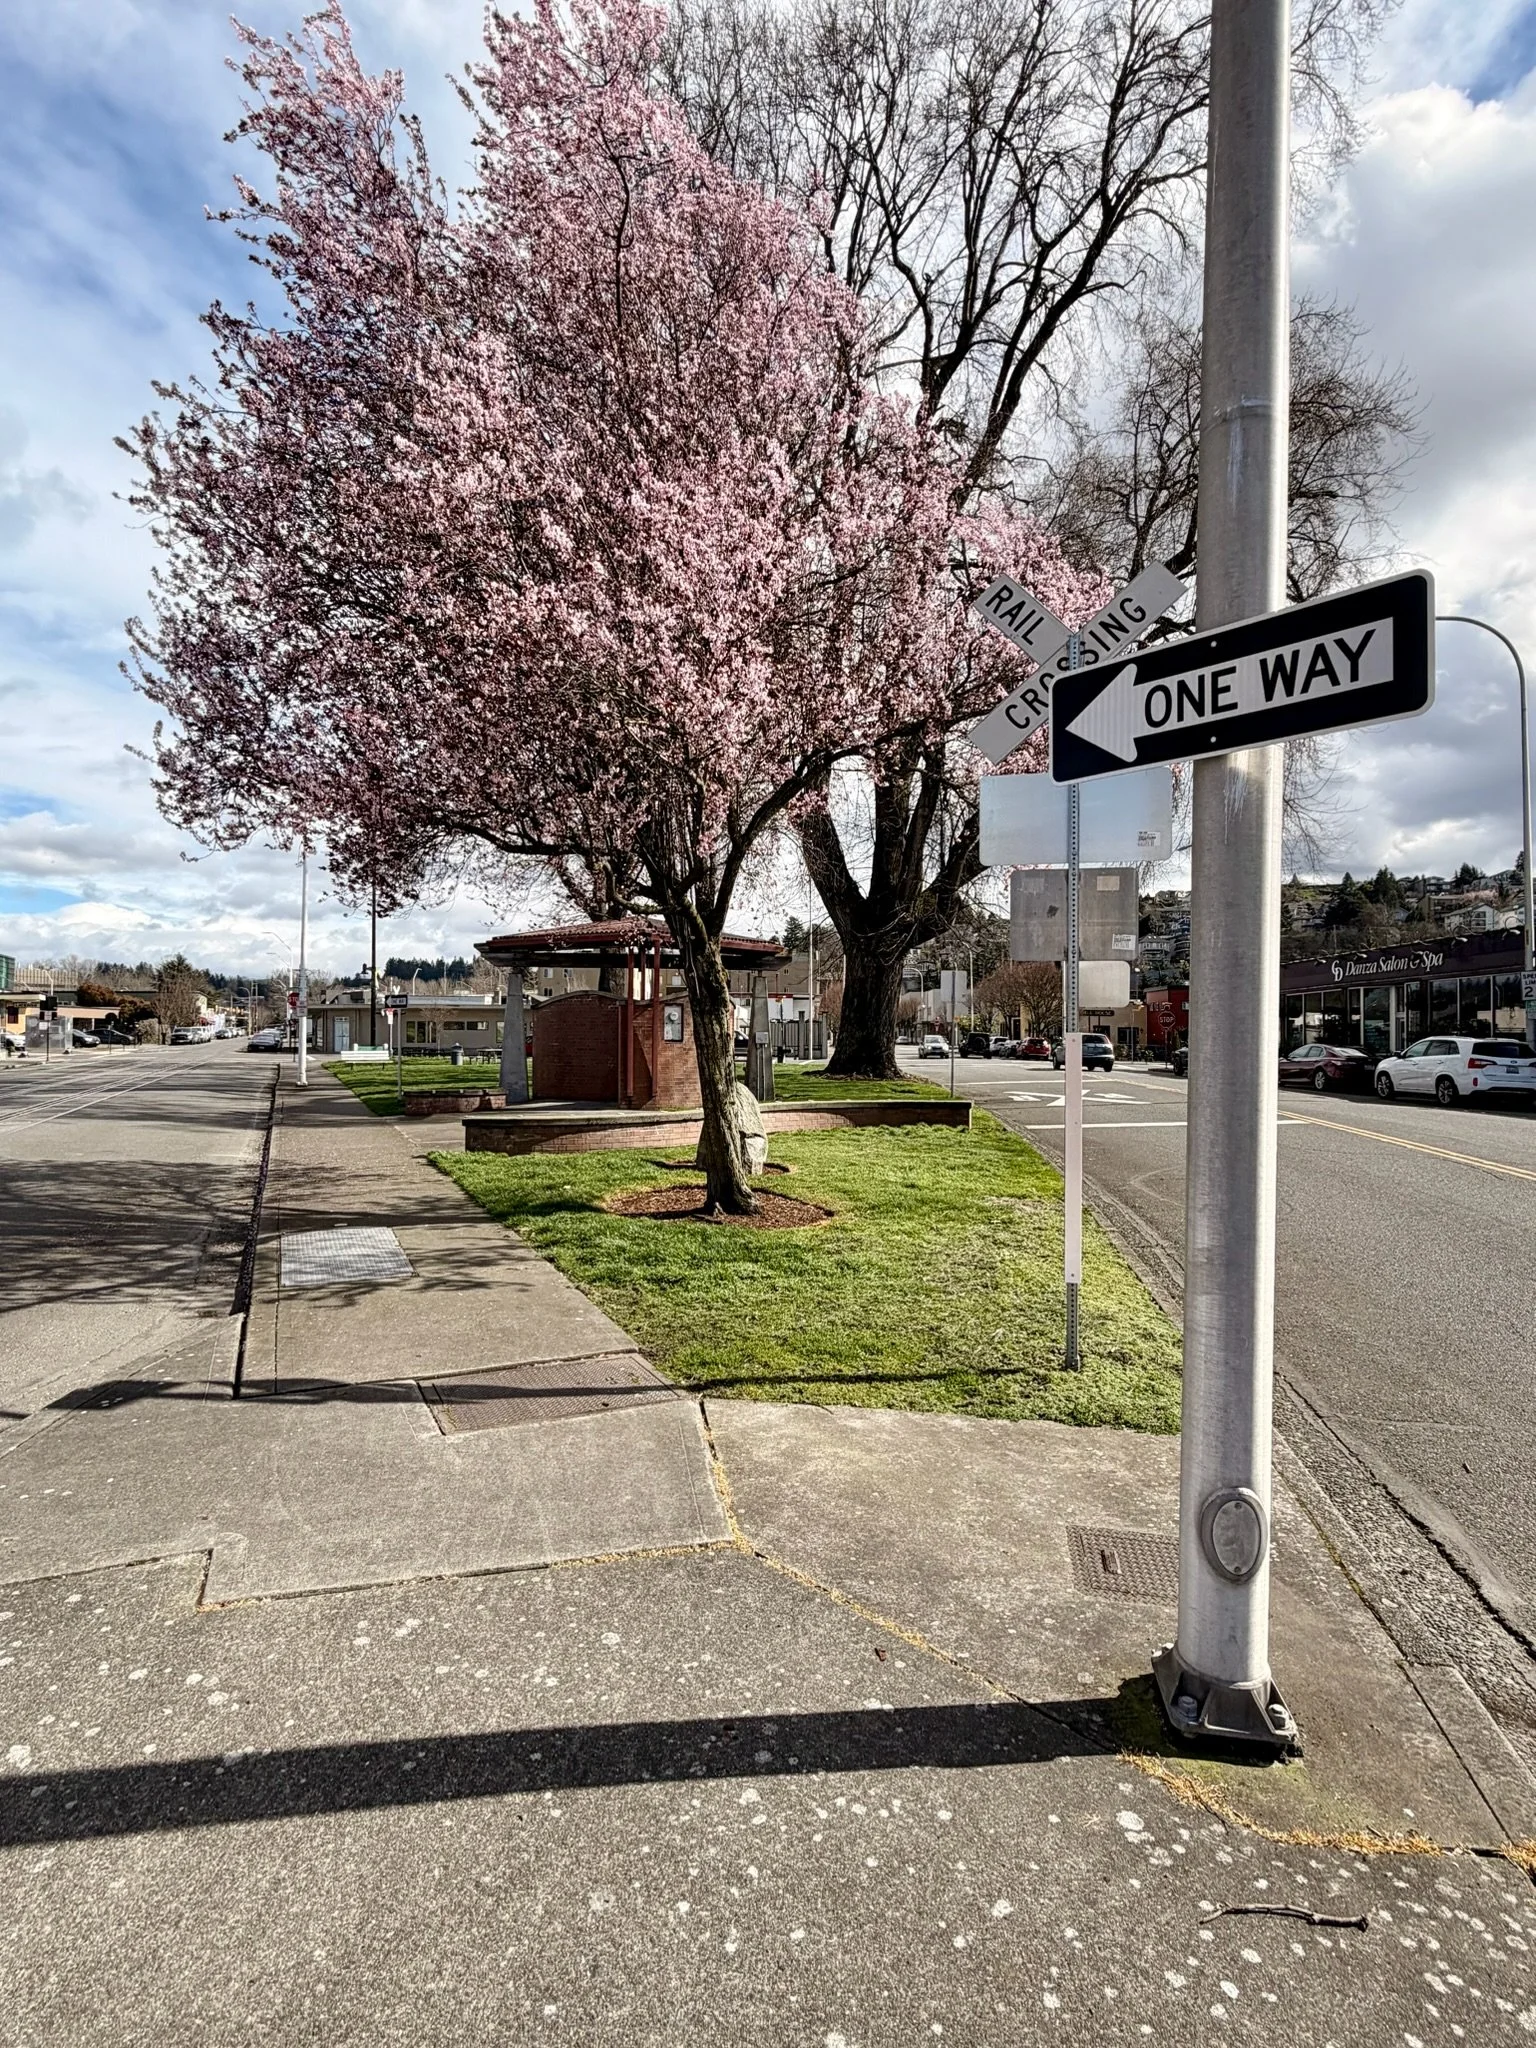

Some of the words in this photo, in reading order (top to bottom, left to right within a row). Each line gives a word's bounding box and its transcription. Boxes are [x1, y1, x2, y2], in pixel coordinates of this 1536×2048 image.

[985, 584, 1044, 646] RAIL
[1145, 666, 1238, 728] ONE
[1259, 628, 1377, 703] WAY
[1345, 961, 1377, 976] Danza
[1378, 955, 1409, 973] Salon
[1421, 950, 1444, 972] Spa
[1524, 986, 1534, 998] 2
